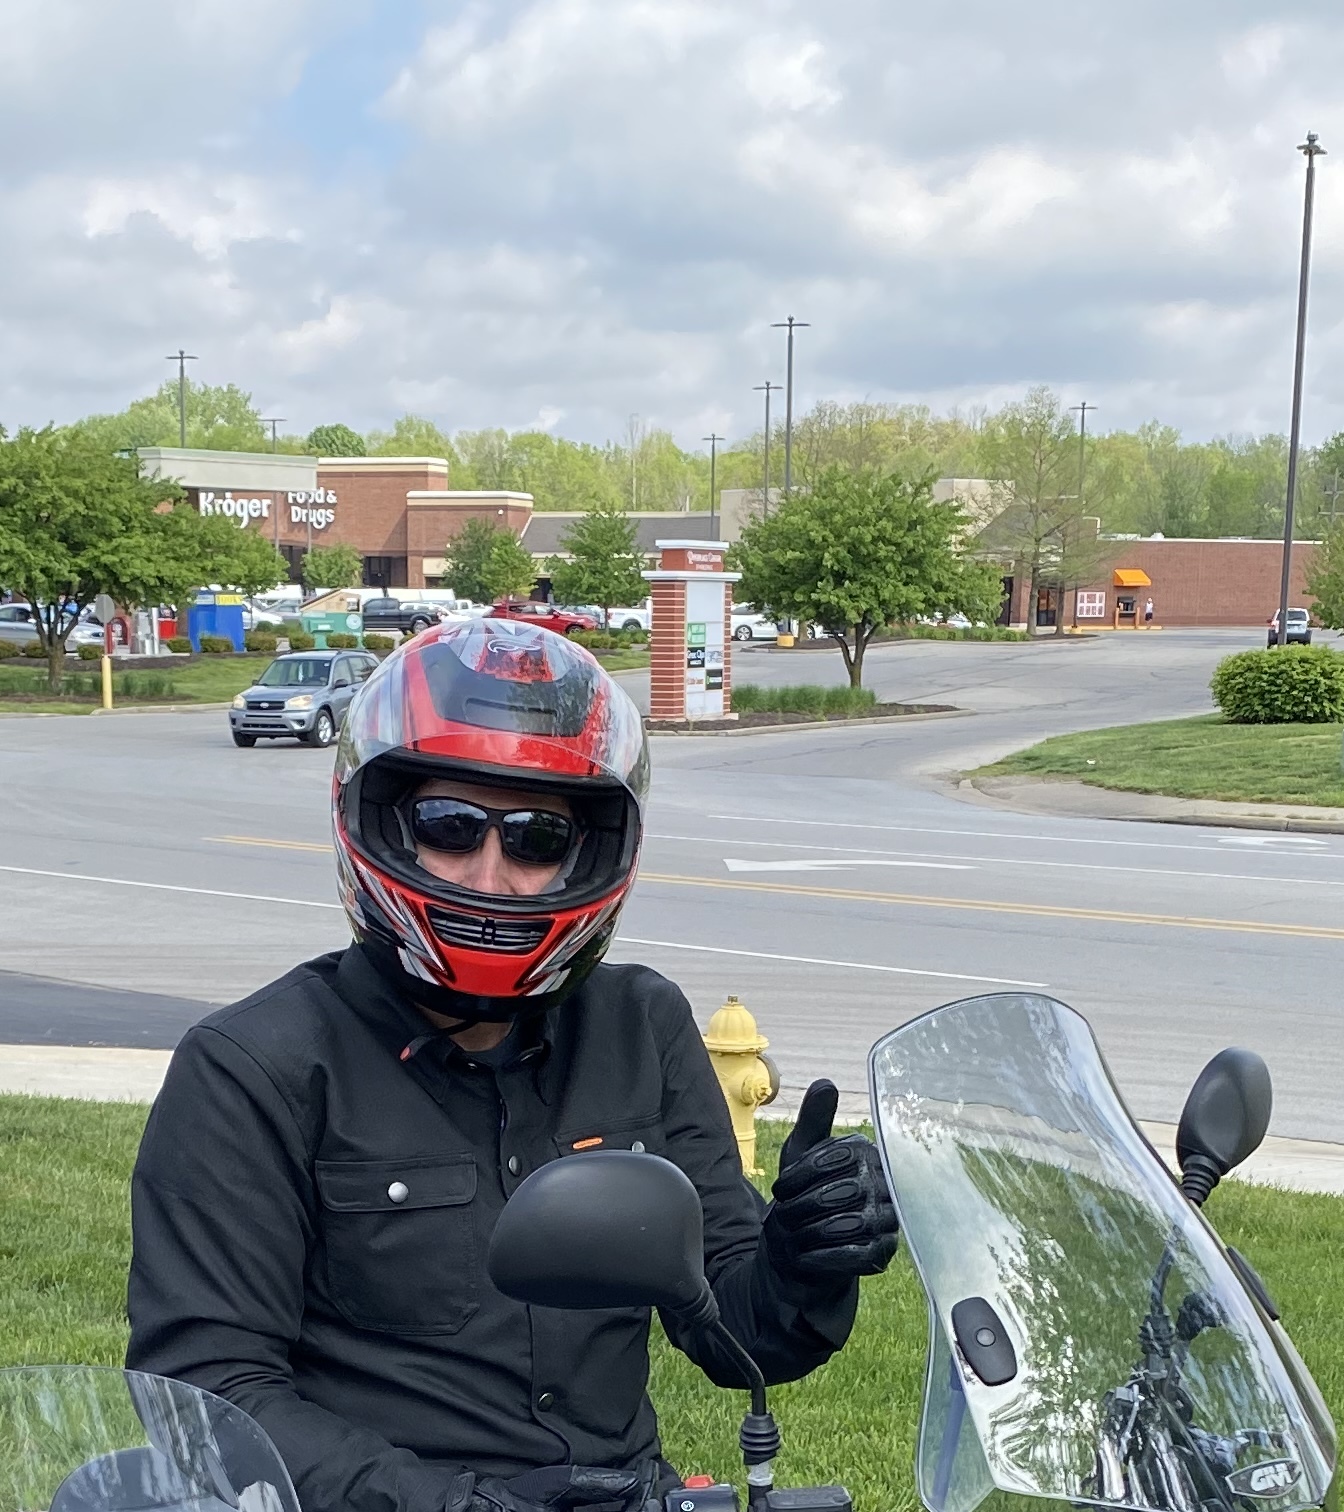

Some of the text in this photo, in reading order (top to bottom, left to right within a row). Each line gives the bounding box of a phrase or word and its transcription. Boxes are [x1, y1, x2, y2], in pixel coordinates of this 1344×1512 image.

[288, 487, 337, 504] Food &
[199, 492, 272, 529] Kroger
[291, 506, 335, 529] Drugs
